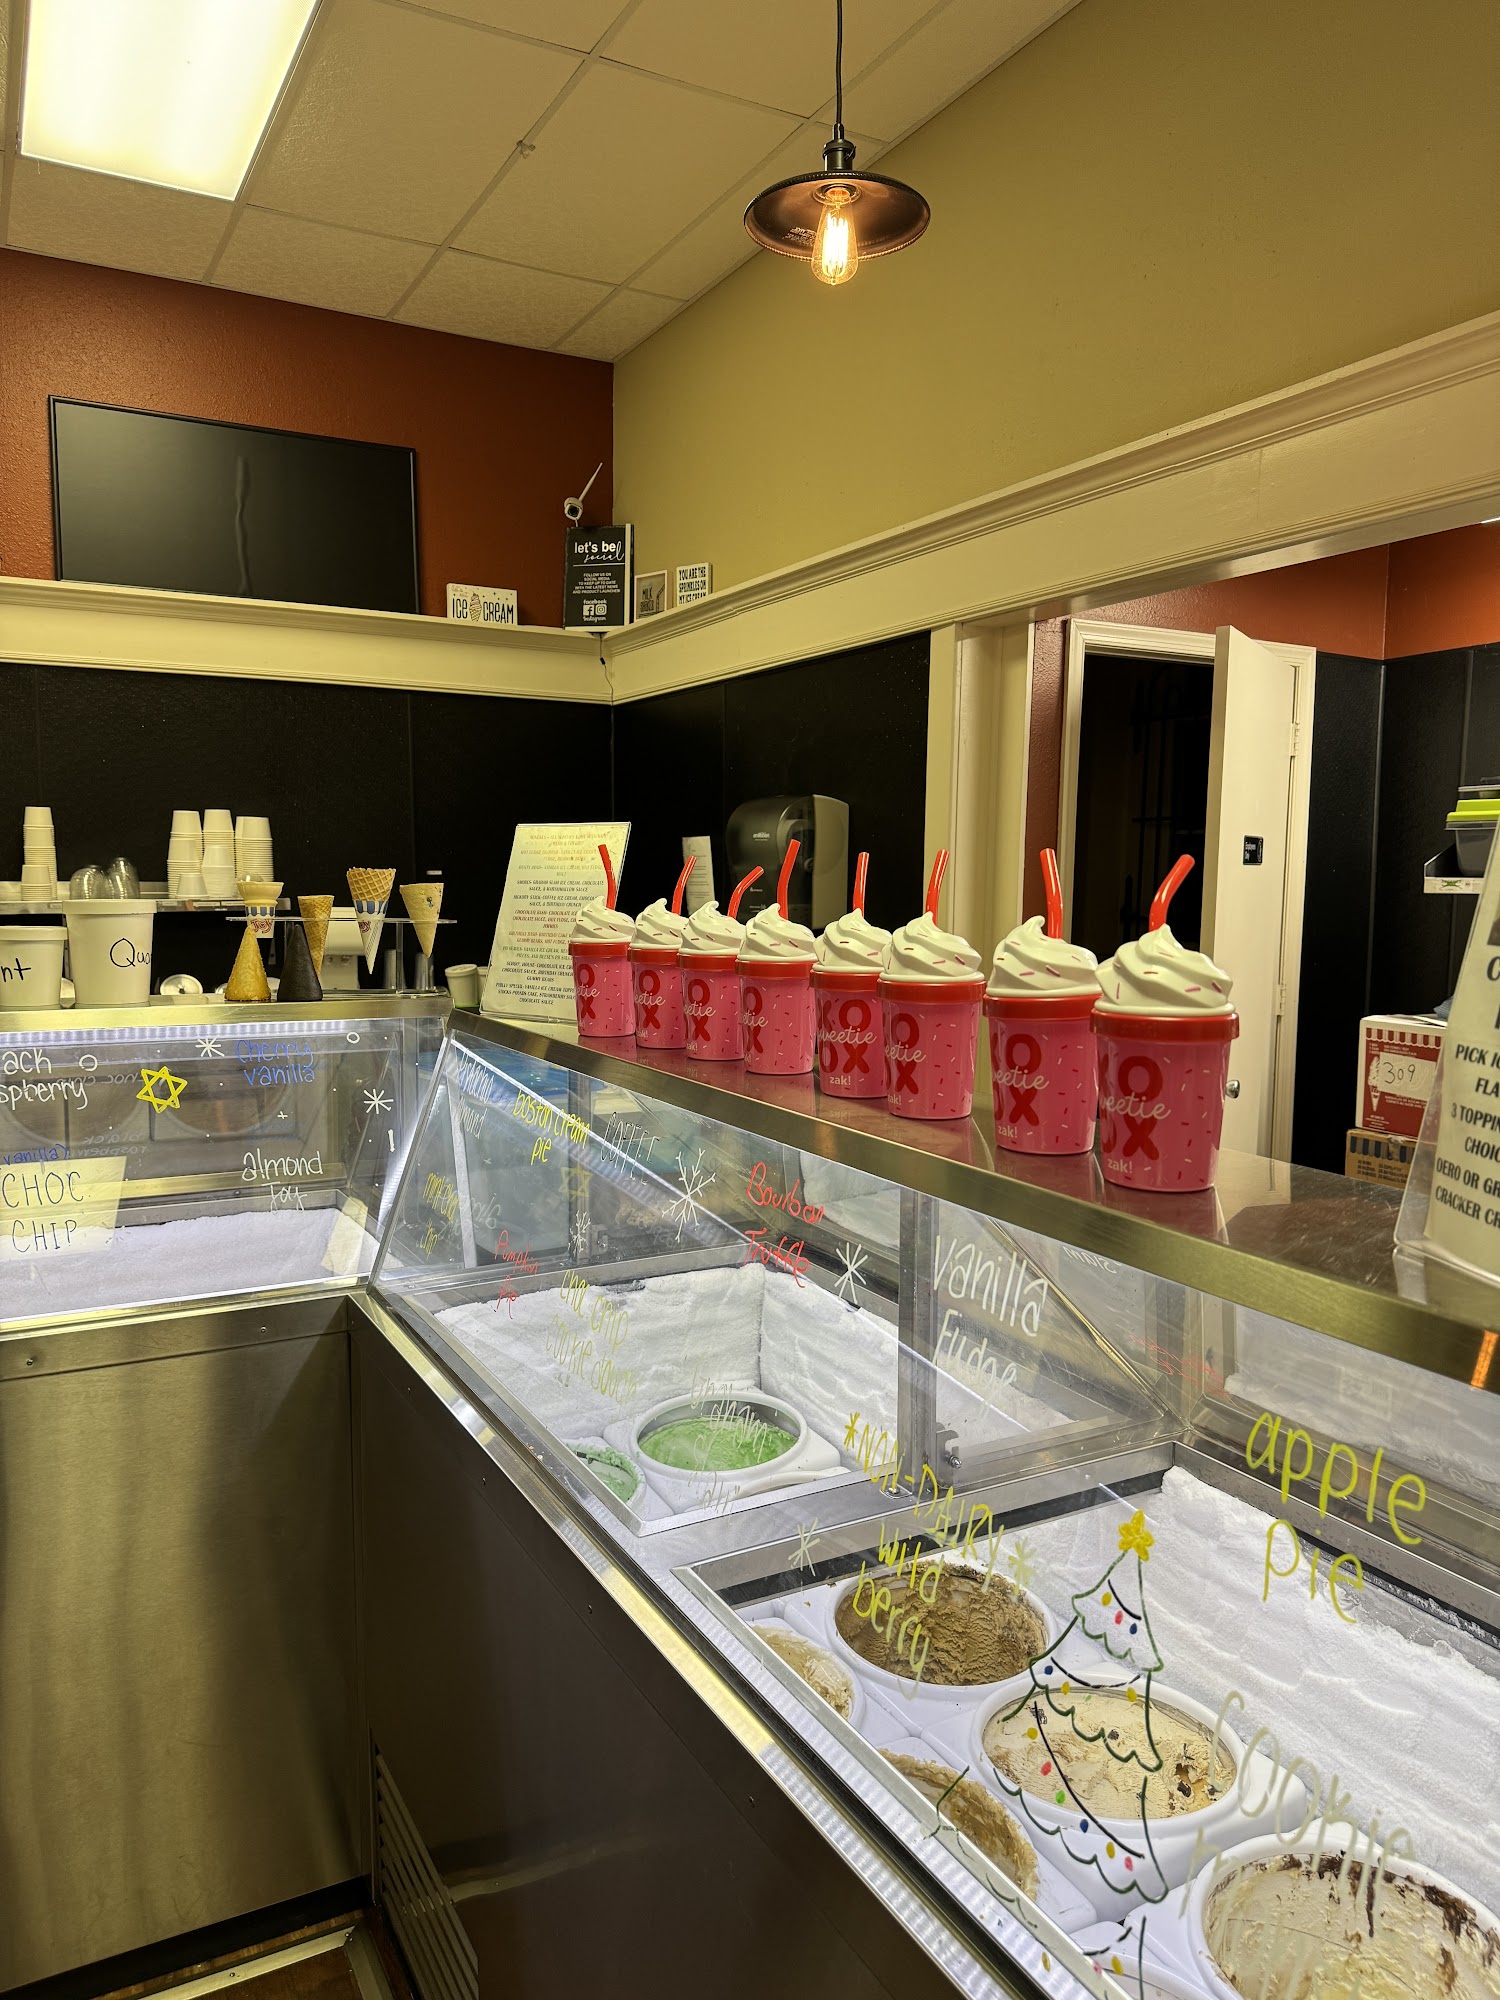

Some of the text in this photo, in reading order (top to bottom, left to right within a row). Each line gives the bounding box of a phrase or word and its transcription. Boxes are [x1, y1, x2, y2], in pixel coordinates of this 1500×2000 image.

[575, 541, 616, 553] let's be
[583, 541, 624, 563] social
[689, 568, 697, 579] ARE
[679, 580, 699, 593] SPRINKLES
[1, 957, 31, 982] nt
[3, 1047, 52, 1075] ack
[1455, 1044, 1490, 1068] PICK
[243, 1063, 315, 1087] vanilla
[829, 1075, 852, 1086] zak!
[1383, 1062, 1416, 1085] 309
[0, 1079, 89, 1110] spberry
[1475, 1077, 1500, 1098] FLA
[1451, 1102, 1457, 1118] 3
[997, 1124, 1018, 1139] zak!
[530, 1136, 552, 1166] pie
[242, 1148, 323, 1182] almond
[1107, 1158, 1134, 1173] zak!
[1463, 1170, 1480, 1189] OR
[1435, 1185, 1481, 1220] CRACKER
[12, 1219, 78, 1253] CHIP
[1246, 1411, 1427, 1545] apple
[878, 1522, 945, 1604] wild
[852, 1560, 930, 1700] berry
